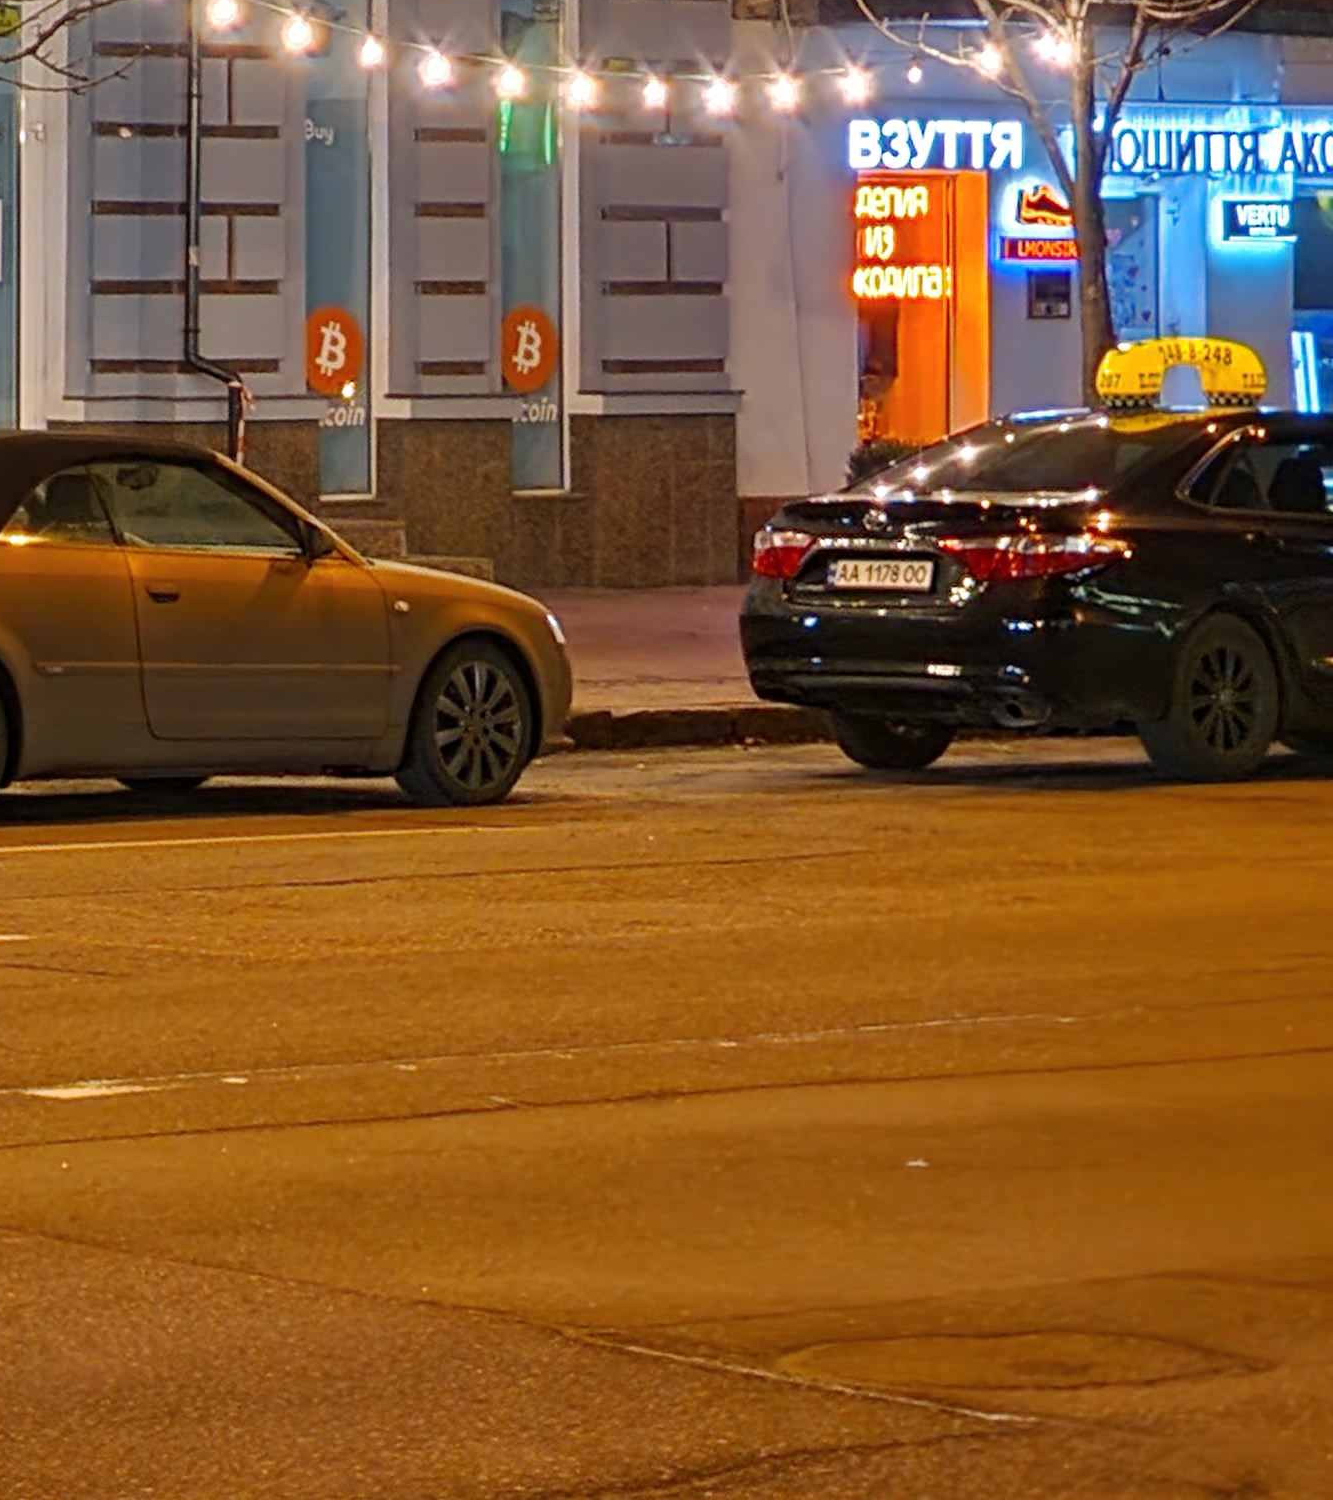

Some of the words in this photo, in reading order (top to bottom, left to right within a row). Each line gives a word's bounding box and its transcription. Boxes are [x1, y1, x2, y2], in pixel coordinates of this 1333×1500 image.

[849, 119, 1023, 168] ВЗУТТЯ
[1109, 127, 1260, 172] ОШИТТЯ
[1236, 204, 1291, 227] VERTU
[319, 400, 365, 428] coin
[839, 564, 859, 582] AA
[864, 564, 900, 583] 1178
